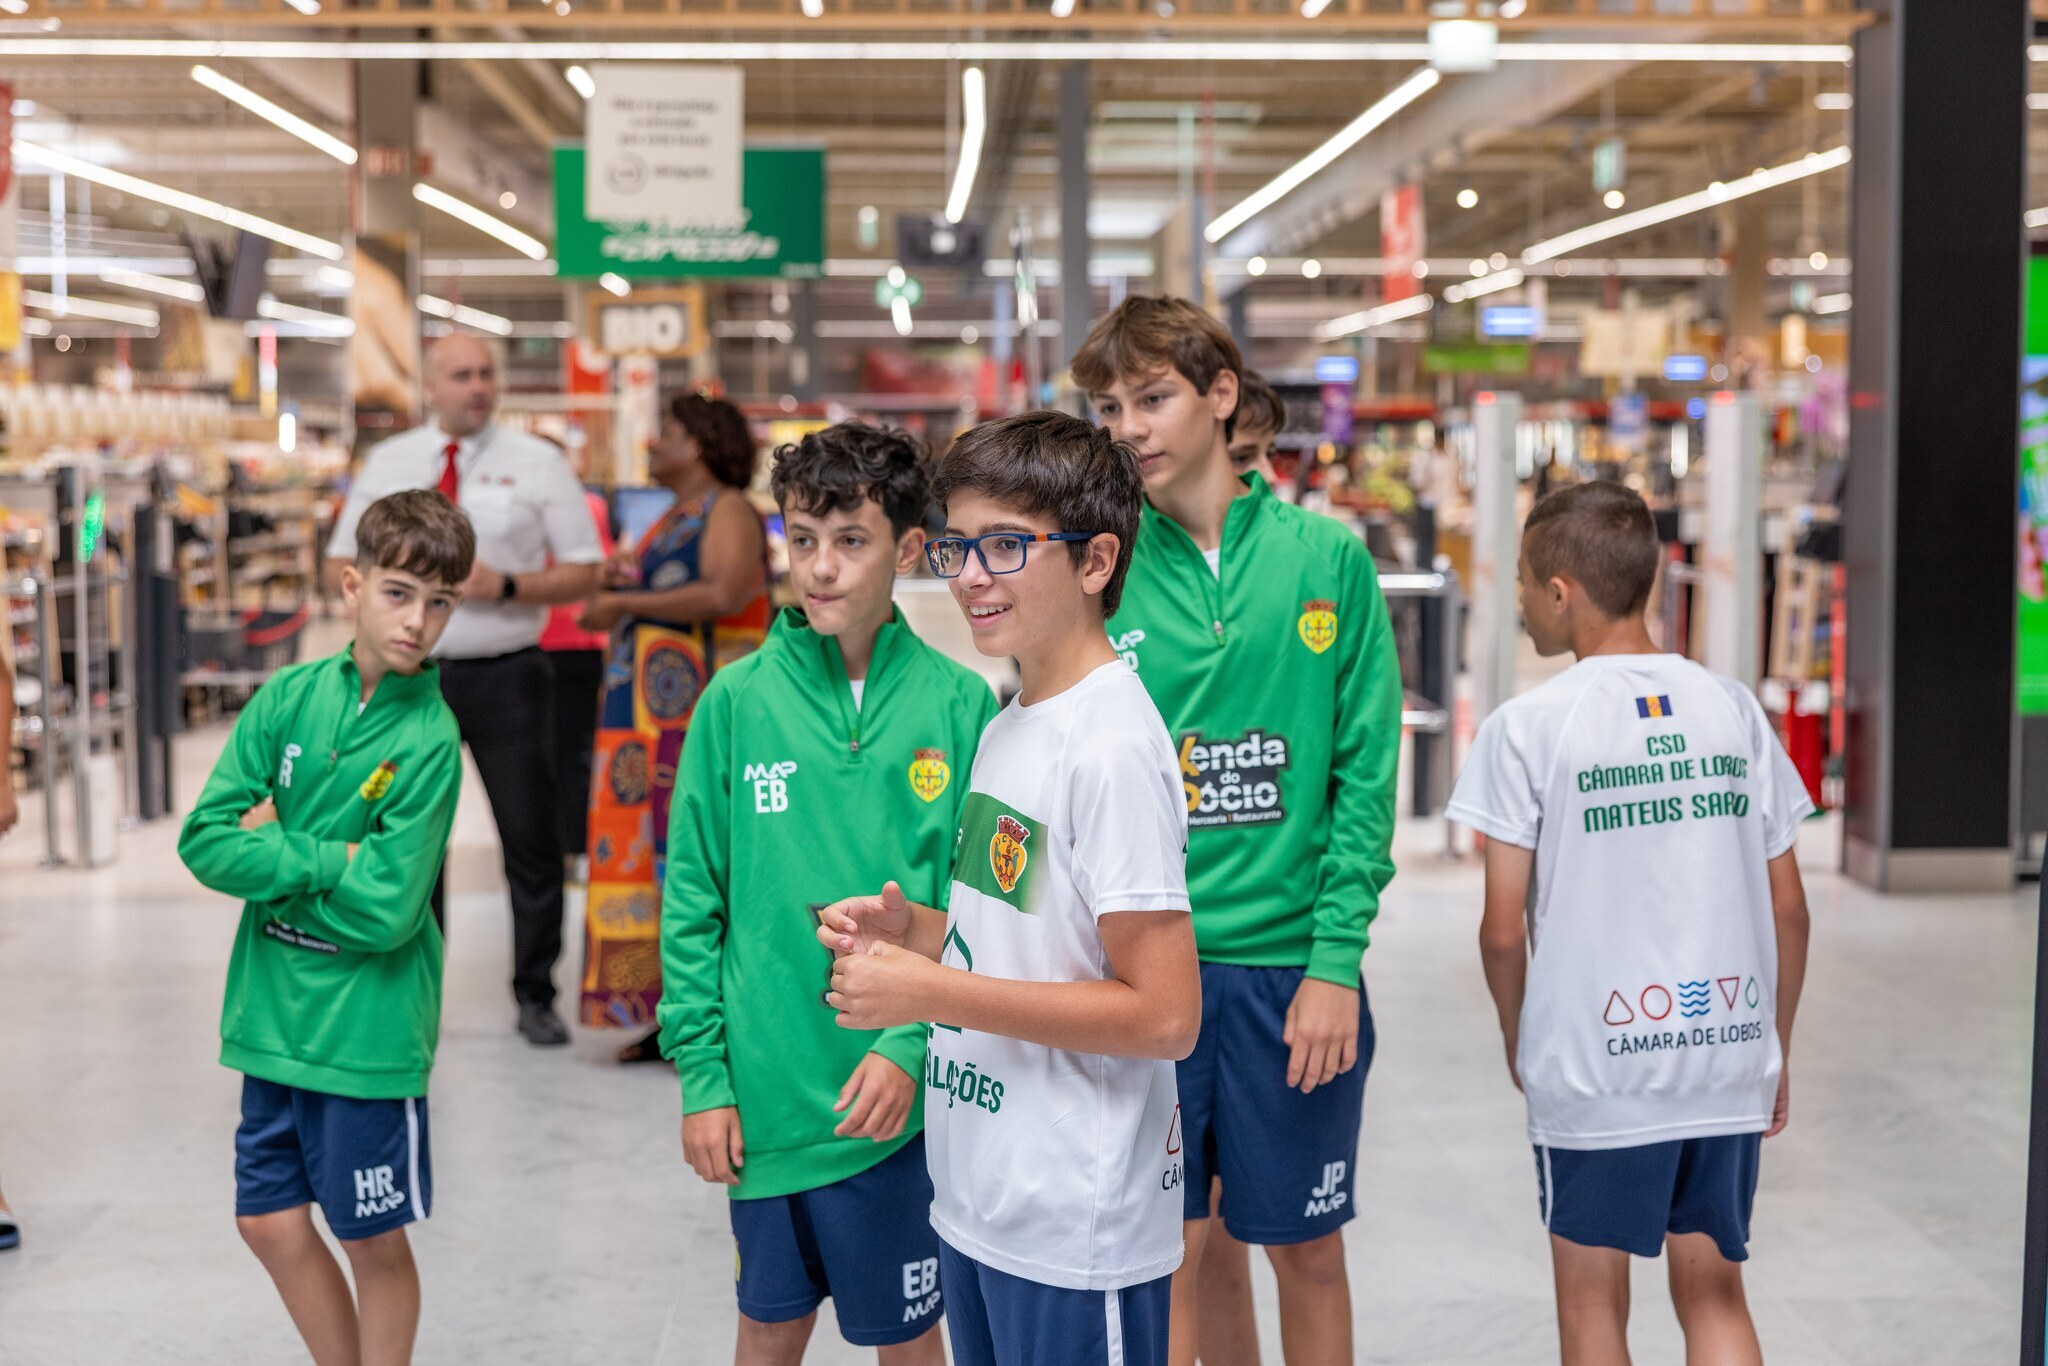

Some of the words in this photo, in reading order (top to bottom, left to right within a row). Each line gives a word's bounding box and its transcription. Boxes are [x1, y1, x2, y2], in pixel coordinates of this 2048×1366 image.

[1646, 734, 1686, 757] CSD
[1219, 770, 1241, 785] do
[1670, 759, 1696, 781] DE
[754, 779, 789, 814] EB
[1231, 810, 1282, 823] Restaurante
[1583, 797, 1683, 833] MATEUS
[1607, 1033, 1688, 1056] CÂMARA
[1693, 1027, 1715, 1046] DE
[1721, 1021, 1763, 1044] LOBOS
[353, 1164, 396, 1200] HR
[1311, 1160, 1347, 1198] JP
[903, 1257, 939, 1300] EB
